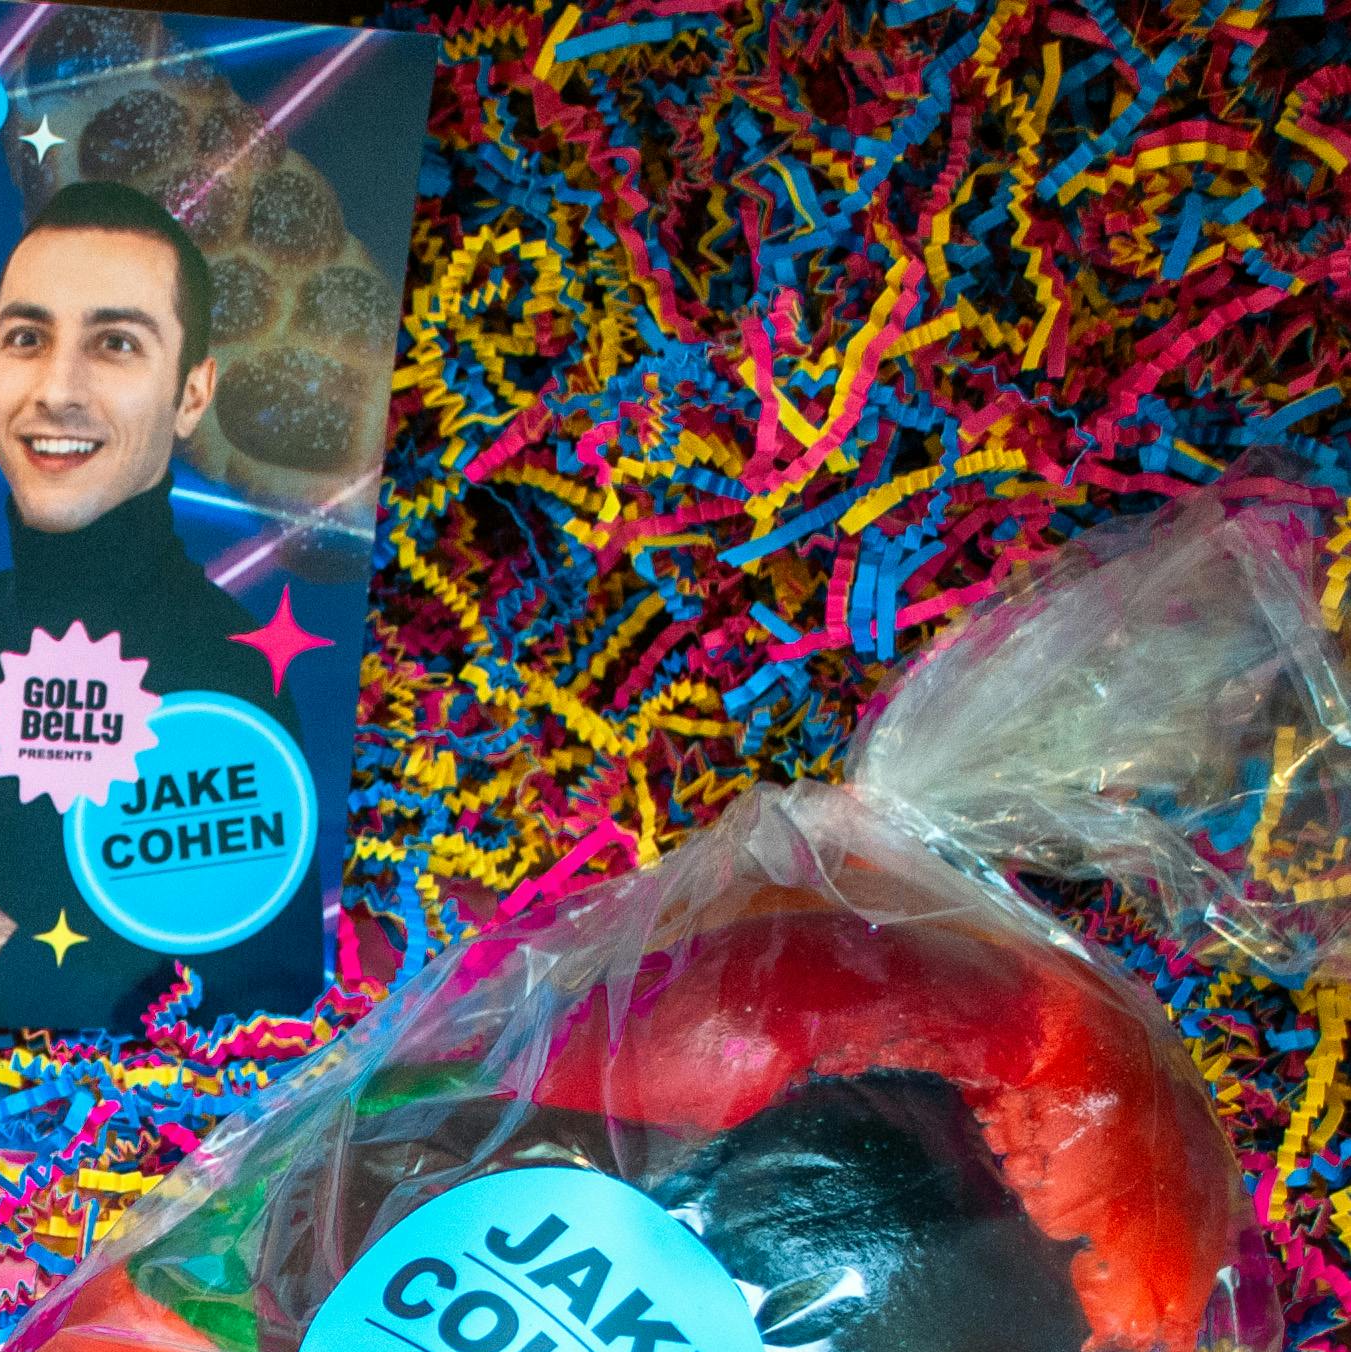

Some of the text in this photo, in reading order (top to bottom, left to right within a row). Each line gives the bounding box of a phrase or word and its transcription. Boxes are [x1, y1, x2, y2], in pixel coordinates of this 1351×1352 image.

[23, 676, 108, 711] GOLD
[18, 748, 93, 762] PRESENTS
[120, 763, 258, 816] JAKE
[101, 812, 285, 870] COHEN
